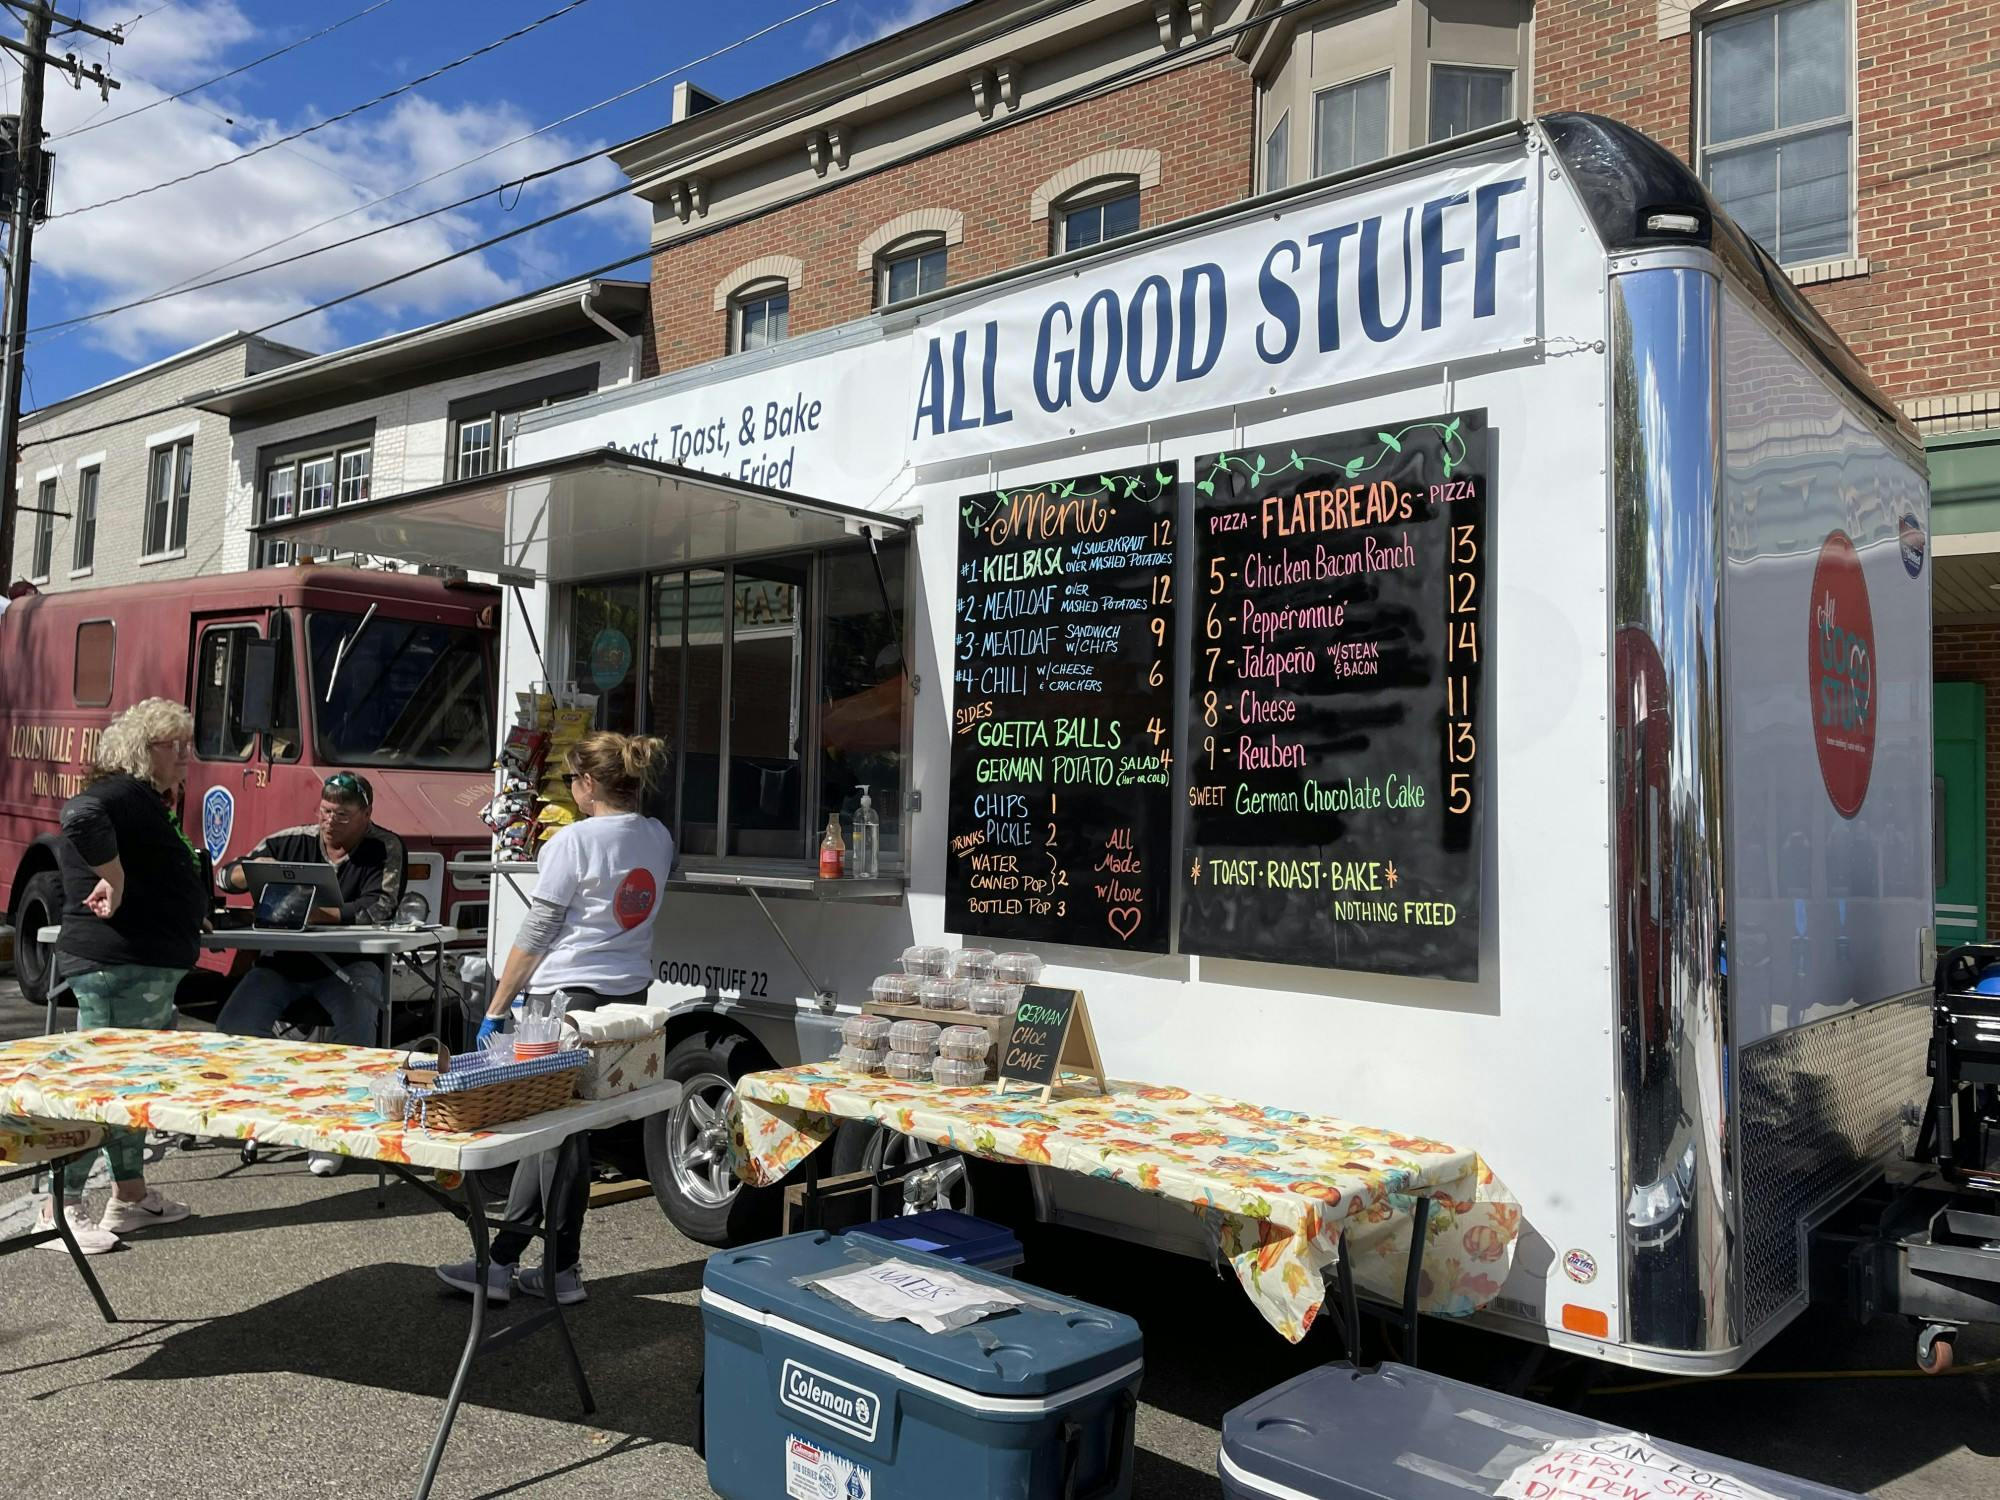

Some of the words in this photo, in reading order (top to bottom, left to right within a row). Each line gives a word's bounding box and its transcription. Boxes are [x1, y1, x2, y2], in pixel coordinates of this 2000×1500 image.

[912, 320, 1013, 441] ALL
[1032, 262, 1228, 413] GOOD
[1255, 177, 1527, 365] STUFF
[607, 433, 662, 462] ast,
[670, 417, 730, 459] Toast,
[739, 406, 755, 447] &
[763, 391, 822, 440] Bake
[739, 447, 794, 489] Fried
[990, 492, 1106, 545] Menu
[983, 547, 1064, 583] KIELBASA
[1154, 520, 1172, 546] 12
[1066, 561, 1087, 573] OVER
[1089, 556, 1126, 571] MASHED
[1129, 552, 1172, 567] POTATOES
[1244, 548, 1311, 588] Chicken
[1316, 544, 1362, 580] Bacon
[1365, 532, 1416, 573] Ranch
[1451, 524, 1477, 564] 13
[983, 585, 1057, 620] MEATLOAF
[1065, 582, 1089, 596] OVER
[1152, 575, 1172, 605] 12
[1061, 601, 1098, 612] MASHED
[1102, 596, 1148, 610] POTATOES
[1450, 572, 1476, 614] 12
[981, 626, 1059, 657] MEATLOAF
[1065, 624, 1120, 639] SANDWICH
[1151, 618, 1165, 646] 9
[1238, 646, 1315, 687] Jalapeño
[1448, 622, 1478, 663] 14
[981, 666, 1027, 696] CHILI
[1149, 660, 1163, 686] 6
[1049, 680, 1103, 692] CRACKERS
[956, 701, 993, 725] SIDES
[1239, 689, 1296, 724] Cheese
[1447, 675, 1468, 716] 11
[10, 725, 75, 763] LOUISVILLE
[80, 728, 102, 764] FIR
[978, 720, 1048, 748] GOETTA
[1054, 717, 1121, 749] BALLS
[1147, 717, 1166, 745] 4
[1238, 734, 1306, 770] Reuben
[1448, 722, 1476, 763] 13
[976, 756, 1043, 783] GERMAN
[1052, 756, 1113, 785] POTATO
[1120, 756, 1159, 771] SALAD
[1160, 748, 1173, 769] 4
[32, 771, 48, 796] AIR
[52, 772, 85, 799] UTILIT
[1189, 785, 1226, 807] SWEET
[1235, 783, 1299, 815] German
[1304, 779, 1381, 812] Chocolate
[1385, 773, 1424, 810] Cake
[1449, 774, 1471, 814] 5
[974, 793, 1028, 818] CHIPS
[951, 830, 985, 852] DRINKS
[986, 819, 1032, 846] PICKLE
[1045, 823, 1057, 847] 2
[971, 855, 1019, 873] WATER
[1057, 871, 1068, 886] 2
[1094, 852, 1141, 873] Made
[1209, 859, 1259, 887] TOAST
[1268, 860, 1321, 889] ROAST
[1331, 862, 1383, 892] BAKE
[971, 875, 1018, 890] CANNED
[1021, 876, 1047, 892] POP
[968, 898, 1022, 914] BOTTLED
[1026, 899, 1050, 915] POP
[1057, 902, 1066, 916] 3
[1335, 901, 1398, 922] NOTHING
[1404, 901, 1456, 926] FRIED
[659, 961, 701, 987] GOOD
[705, 966, 746, 992] STUFF
[750, 971, 768, 997] 22
[1017, 1003, 1068, 1027] GERMAN
[1012, 1027, 1047, 1046] CHOC
[1006, 1050, 1048, 1071] CAKE
[790, 1370, 853, 1417] Coleman
[1552, 1452, 1634, 1480] PEPSI
[1590, 1440, 1654, 1464] CAN
[1586, 1476, 1653, 1500] DEW
